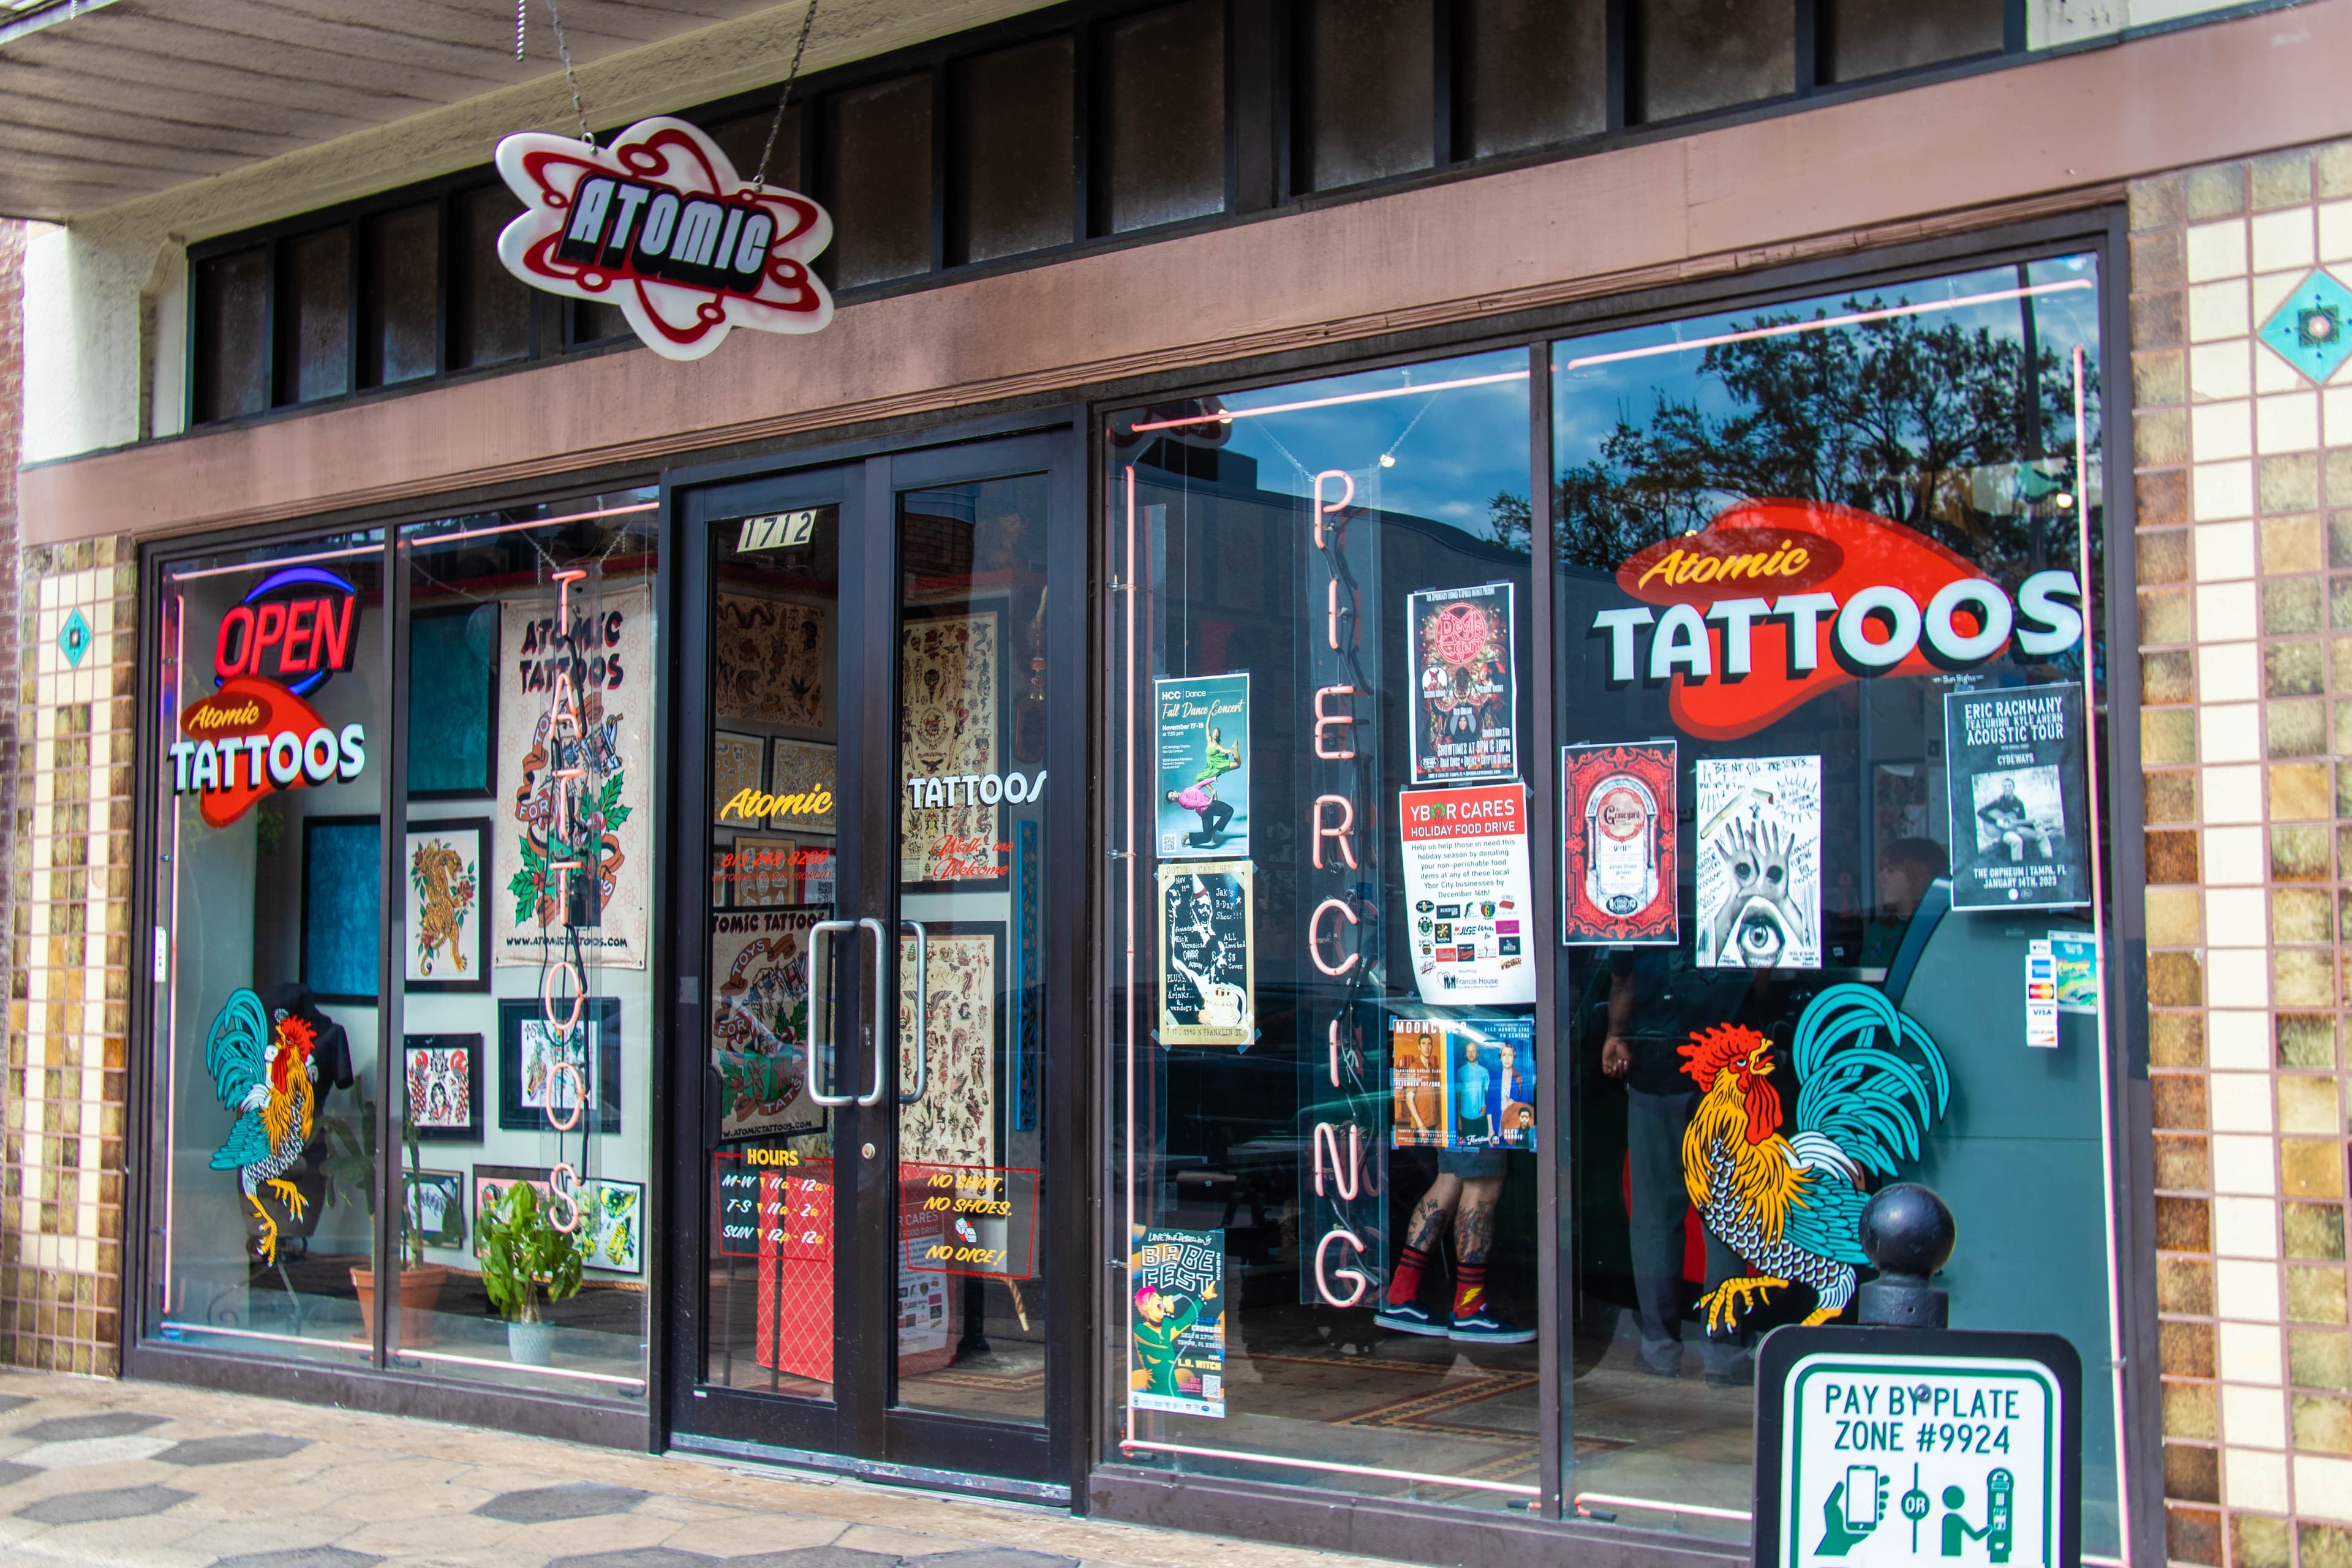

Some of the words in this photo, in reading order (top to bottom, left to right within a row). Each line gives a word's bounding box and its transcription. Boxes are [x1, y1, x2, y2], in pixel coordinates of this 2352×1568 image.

[568, 178, 773, 274] ATOMIC
[745, 513, 812, 548] 1712
[1637, 539, 1811, 590] Atomic
[1593, 570, 2082, 681] TATTOOS
[215, 596, 353, 677] OPEN
[519, 653, 624, 695] TATTOOS
[1161, 691, 1181, 700] HCC
[189, 700, 260, 731] Atomic
[1162, 703, 1180, 720] Fall
[1182, 702, 1208, 718] Dance
[1212, 699, 1245, 715] Concert
[1965, 702, 1992, 720] ERIC
[1996, 696, 2062, 718] RACHMANY
[534, 700, 567, 745] TOS
[1966, 717, 2010, 731] FEATURING
[2014, 714, 2034, 727] KYLE
[1967, 726, 2027, 746] ACOUSTIC
[2031, 723, 2064, 742] TOUR
[168, 723, 365, 791] TATTOOS
[1437, 742, 1467, 756] SHOWTIMES
[1468, 742, 1476, 754] AT
[1476, 740, 1489, 753] 9PM
[1496, 739, 1510, 752] 10PM
[1713, 761, 1744, 774] BENT
[1997, 752, 2035, 766] CYDEWAYS
[908, 771, 1047, 809] TATTOOS
[519, 799, 549, 819] FOR
[720, 783, 833, 821] Atomic
[1461, 799, 1515, 819] CARES
[1604, 805, 1640, 826] Graveyard
[1411, 825, 1452, 837] HOLIDAY
[1455, 823, 1482, 835] FOOD
[1485, 821, 1515, 832] DRIVE
[933, 858, 1009, 879] Welcome
[1437, 859, 1489, 869] non-perishable
[1973, 867, 1988, 879] THE
[1989, 866, 2024, 878] ORPHEUM
[1309, 469, 1365, 1306] PIERCING
[1455, 879, 1494, 888] businesses
[1983, 878, 2016, 889] JANUARY
[2040, 875, 2057, 887] 2023
[546, 570, 586, 1233] TATTOOS
[1216, 888, 1234, 897] Jak's
[1438, 890, 1472, 899] December
[1216, 900, 1234, 910] B-Day
[714, 913, 759, 934] TOMIC
[732, 939, 765, 976] TOYS
[1227, 952, 1235, 962] $8
[717, 1018, 747, 1035] FOR
[1204, 1028, 1233, 1036] FRANKLIN
[764, 1077, 802, 1114] TATS
[747, 1148, 799, 1167] HOURS
[722, 1174, 756, 1188] M-W
[769, 1177, 790, 1190] 11a
[801, 1178, 824, 1192] 12a
[927, 1174, 953, 1189] NO
[726, 1199, 752, 1213] T-S
[767, 1202, 788, 1216] 11a
[800, 1204, 820, 1217] 2a
[923, 1196, 951, 1211] NO
[907, 1210, 939, 1226] CARES
[723, 1225, 755, 1240] SUN
[767, 1228, 790, 1244] 12p
[801, 1231, 824, 1244] 12a
[925, 1245, 954, 1260] NO
[955, 1246, 1007, 1267] DICE!
[1142, 1243, 1216, 1272] BABE
[1142, 1263, 1213, 1295] FEST
[1177, 1358, 1194, 1368] L.A.
[1196, 1360, 1221, 1371] WITCH
[1825, 1384, 1879, 1415] PAY
[1889, 1386, 1923, 1416] BY
[1934, 1389, 2020, 1420] PLATE
[1834, 1420, 1904, 1452] ZONE
[1917, 1423, 2010, 1455] #9924
[1905, 1497, 1926, 1513] OR
